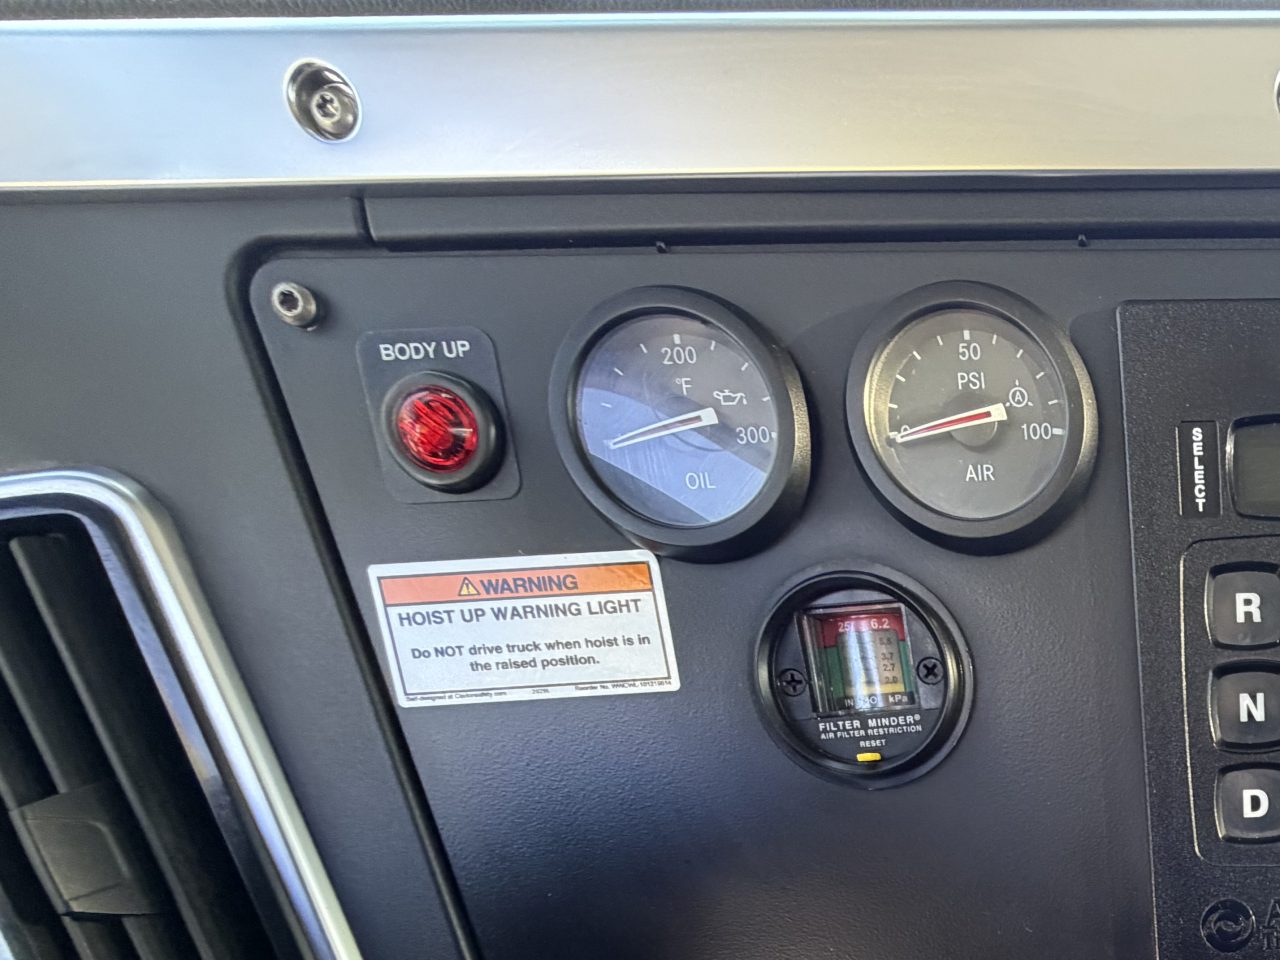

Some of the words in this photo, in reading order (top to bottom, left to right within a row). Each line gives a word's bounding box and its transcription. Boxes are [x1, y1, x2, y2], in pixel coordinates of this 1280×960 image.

[378, 341, 437, 361] BODY
[441, 340, 471, 358] UP
[661, 346, 697, 365] 200
[958, 342, 981, 361] 50
[675, 377, 692, 396] °F
[957, 371, 985, 391] PSI
[735, 426, 770, 444] 300
[1021, 422, 1051, 441] 100
[965, 464, 995, 482] AIR
[1191, 427, 1206, 513] SELECT
[685, 471, 716, 490] OIL
[480, 573, 579, 595] WARNING
[398, 609, 455, 627] HOIST
[461, 607, 486, 624] UP
[491, 601, 583, 622] WARNING
[587, 598, 642, 616] LIGHT
[1235, 592, 1262, 624] R
[870, 618, 890, 629] 6.2
[411, 648, 431, 660] Do
[434, 645, 464, 659] NOT
[468, 643, 502, 657] drive
[506, 641, 542, 655] truck
[544, 639, 582, 652] when
[585, 636, 619, 649] hoist
[621, 635, 635, 647] is
[638, 634, 651, 645] in
[469, 660, 492, 672] the
[495, 657, 537, 671] raised
[540, 653, 600, 670] position.
[882, 663, 896, 672] 2.7
[888, 694, 909, 703] kPa
[1238, 692, 1265, 722] N
[818, 720, 861, 732] FILTER
[820, 732, 835, 740] AIR
[837, 730, 866, 738] FILTER
[867, 724, 922, 736] RESTRICTION
[859, 739, 886, 748] RESET
[1242, 788, 1269, 818] D
